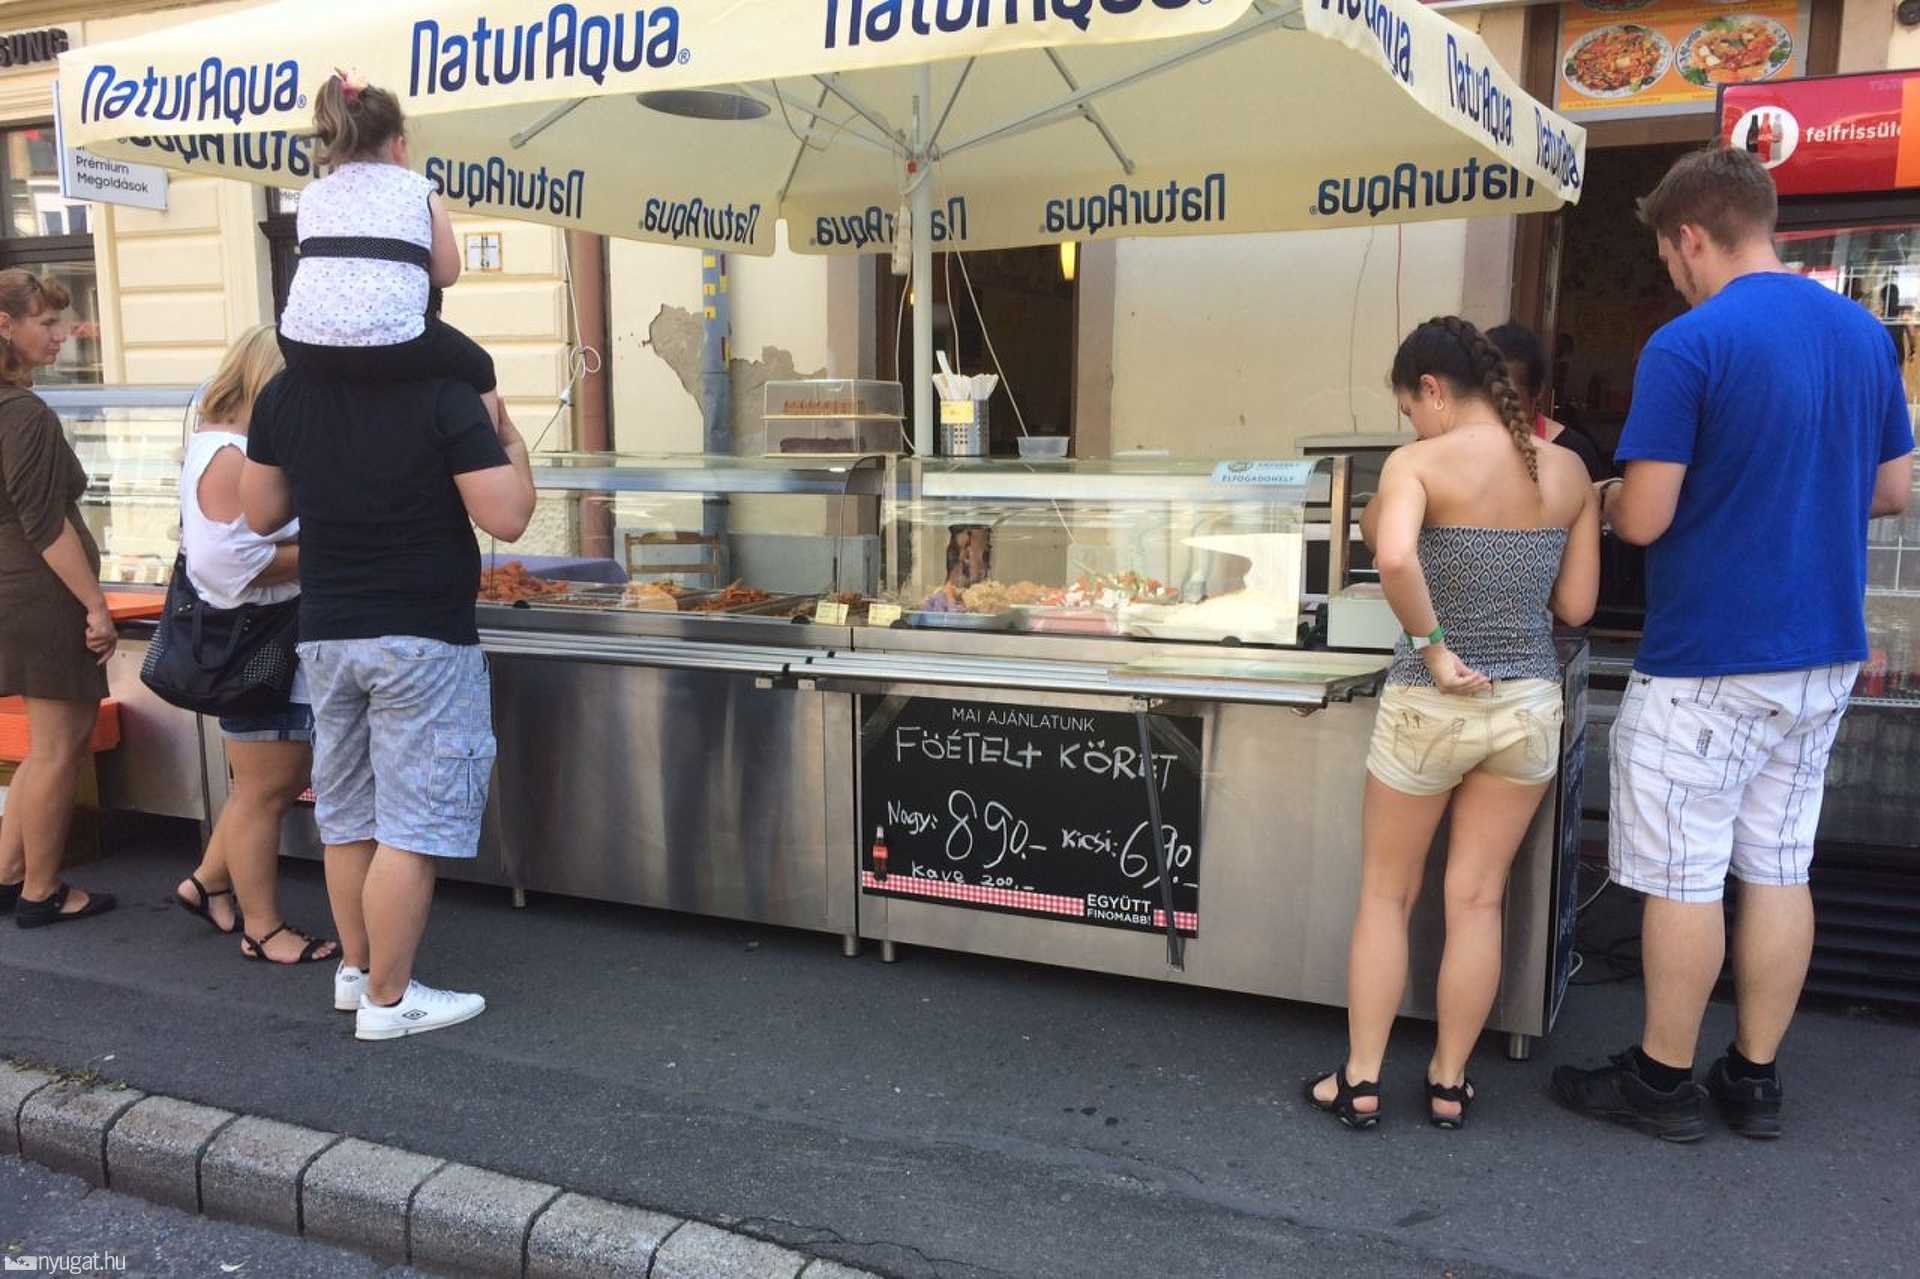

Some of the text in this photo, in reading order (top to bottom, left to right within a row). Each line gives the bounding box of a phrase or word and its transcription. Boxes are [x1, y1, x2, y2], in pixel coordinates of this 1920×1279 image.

[408, 3, 680, 96] NaturAqua
[81, 57, 299, 126] NaturAqua
[952, 707, 1095, 733] MAI AJÁNLATUNK
[1087, 893, 1151, 913] EGYÜTT
